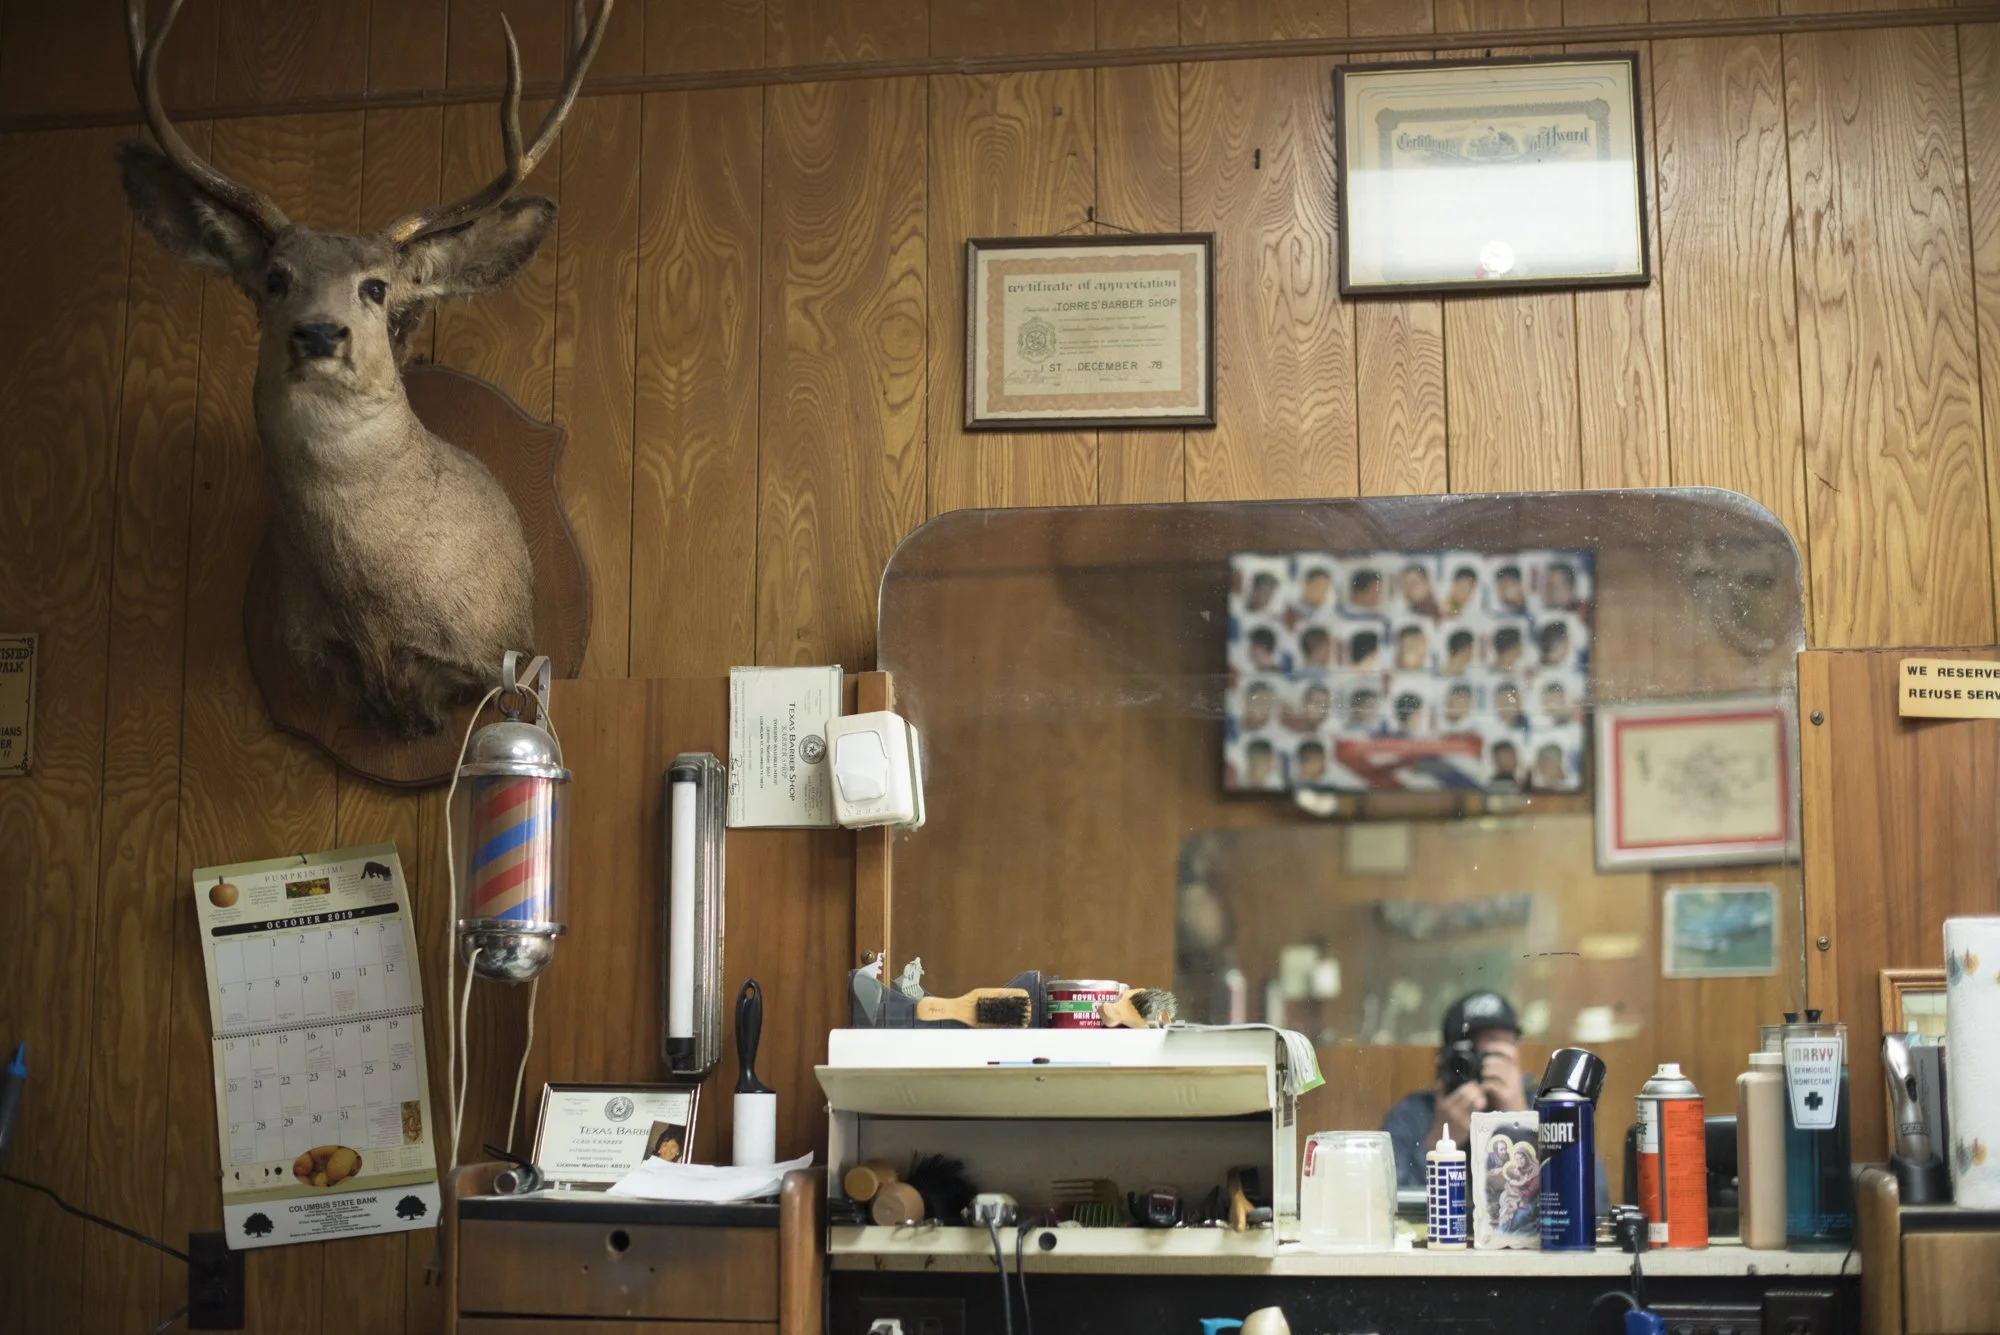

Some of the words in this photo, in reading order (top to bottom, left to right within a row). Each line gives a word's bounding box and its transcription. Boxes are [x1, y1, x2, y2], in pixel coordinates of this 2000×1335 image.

[1078, 279, 1091, 291] of
[1101, 299, 1143, 310] BARBER
[1148, 298, 1177, 308] SHOP
[1077, 361, 1138, 372] DECEMBER
[1907, 666, 1927, 676] WE
[1937, 668, 2000, 679] RESERVE
[788, 701, 796, 732] TEXAS
[788, 735, 796, 773] BARBER
[788, 775, 796, 802] SHOP
[264, 871, 316, 883] PUMPKIN
[321, 865, 345, 877] TIME
[266, 915, 321, 930] OCTOBER
[328, 910, 353, 922] 2019
[272, 938, 276, 947] 1
[299, 934, 305, 944] 2
[327, 931, 333, 939] 3
[353, 927, 359, 936] 4
[379, 923, 385, 932] 5
[220, 986, 226, 994] 6
[247, 982, 253, 991] 7
[275, 979, 280, 988] 8
[302, 975, 308, 984] 9
[331, 971, 341, 980] 10
[358, 967, 367, 976] 11
[385, 963, 395, 973] 12
[1072, 993, 1096, 1001] ROYAL
[1097, 993, 1117, 1001] CROW
[1073, 1012, 1091, 1020] HAIR
[225, 1041, 235, 1051] 13
[251, 1038, 261, 1048] 14
[278, 1035, 288, 1044] 15
[306, 1031, 316, 1041] 16
[334, 1027, 344, 1037] 17
[361, 1023, 371, 1033] 18
[388, 1020, 398, 1030] 19
[1792, 1047, 1834, 1062] MARVY
[228, 1083, 237, 1093] 20
[253, 1080, 262, 1089] 21
[280, 1076, 291, 1086] 22
[309, 1072, 319, 1082] 23
[336, 1069, 347, 1079] 24
[364, 1065, 374, 1075] 25
[391, 1062, 401, 1072] 26
[230, 1124, 240, 1134] 27
[256, 1121, 266, 1131] 28
[283, 1118, 294, 1127] 29
[311, 1114, 322, 1124] 30
[340, 1111, 349, 1121] 31
[579, 1126, 612, 1135] TEXAS
[616, 1126, 650, 1136] BARBE
[1538, 1122, 1574, 1143] NSORT
[289, 1201, 331, 1213] COLUMBUS
[332, 1199, 355, 1208] STATE
[356, 1196, 378, 1205] BANK
